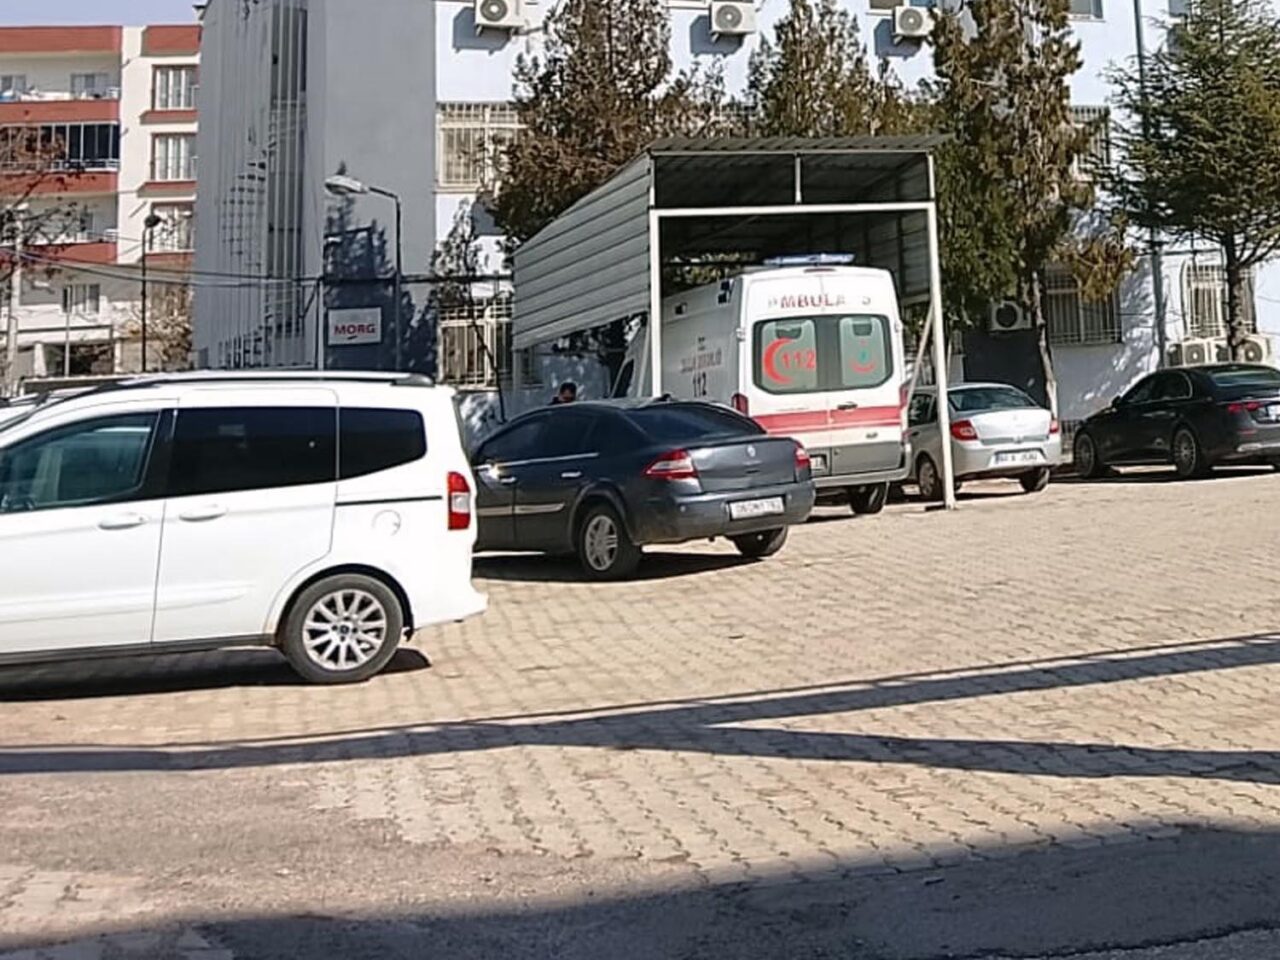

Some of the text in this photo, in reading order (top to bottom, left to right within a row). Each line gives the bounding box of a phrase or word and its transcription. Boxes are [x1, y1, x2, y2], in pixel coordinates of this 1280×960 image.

[335, 324, 376, 335] MORG
[782, 348, 816, 371] 112
[692, 371, 707, 398] 112
